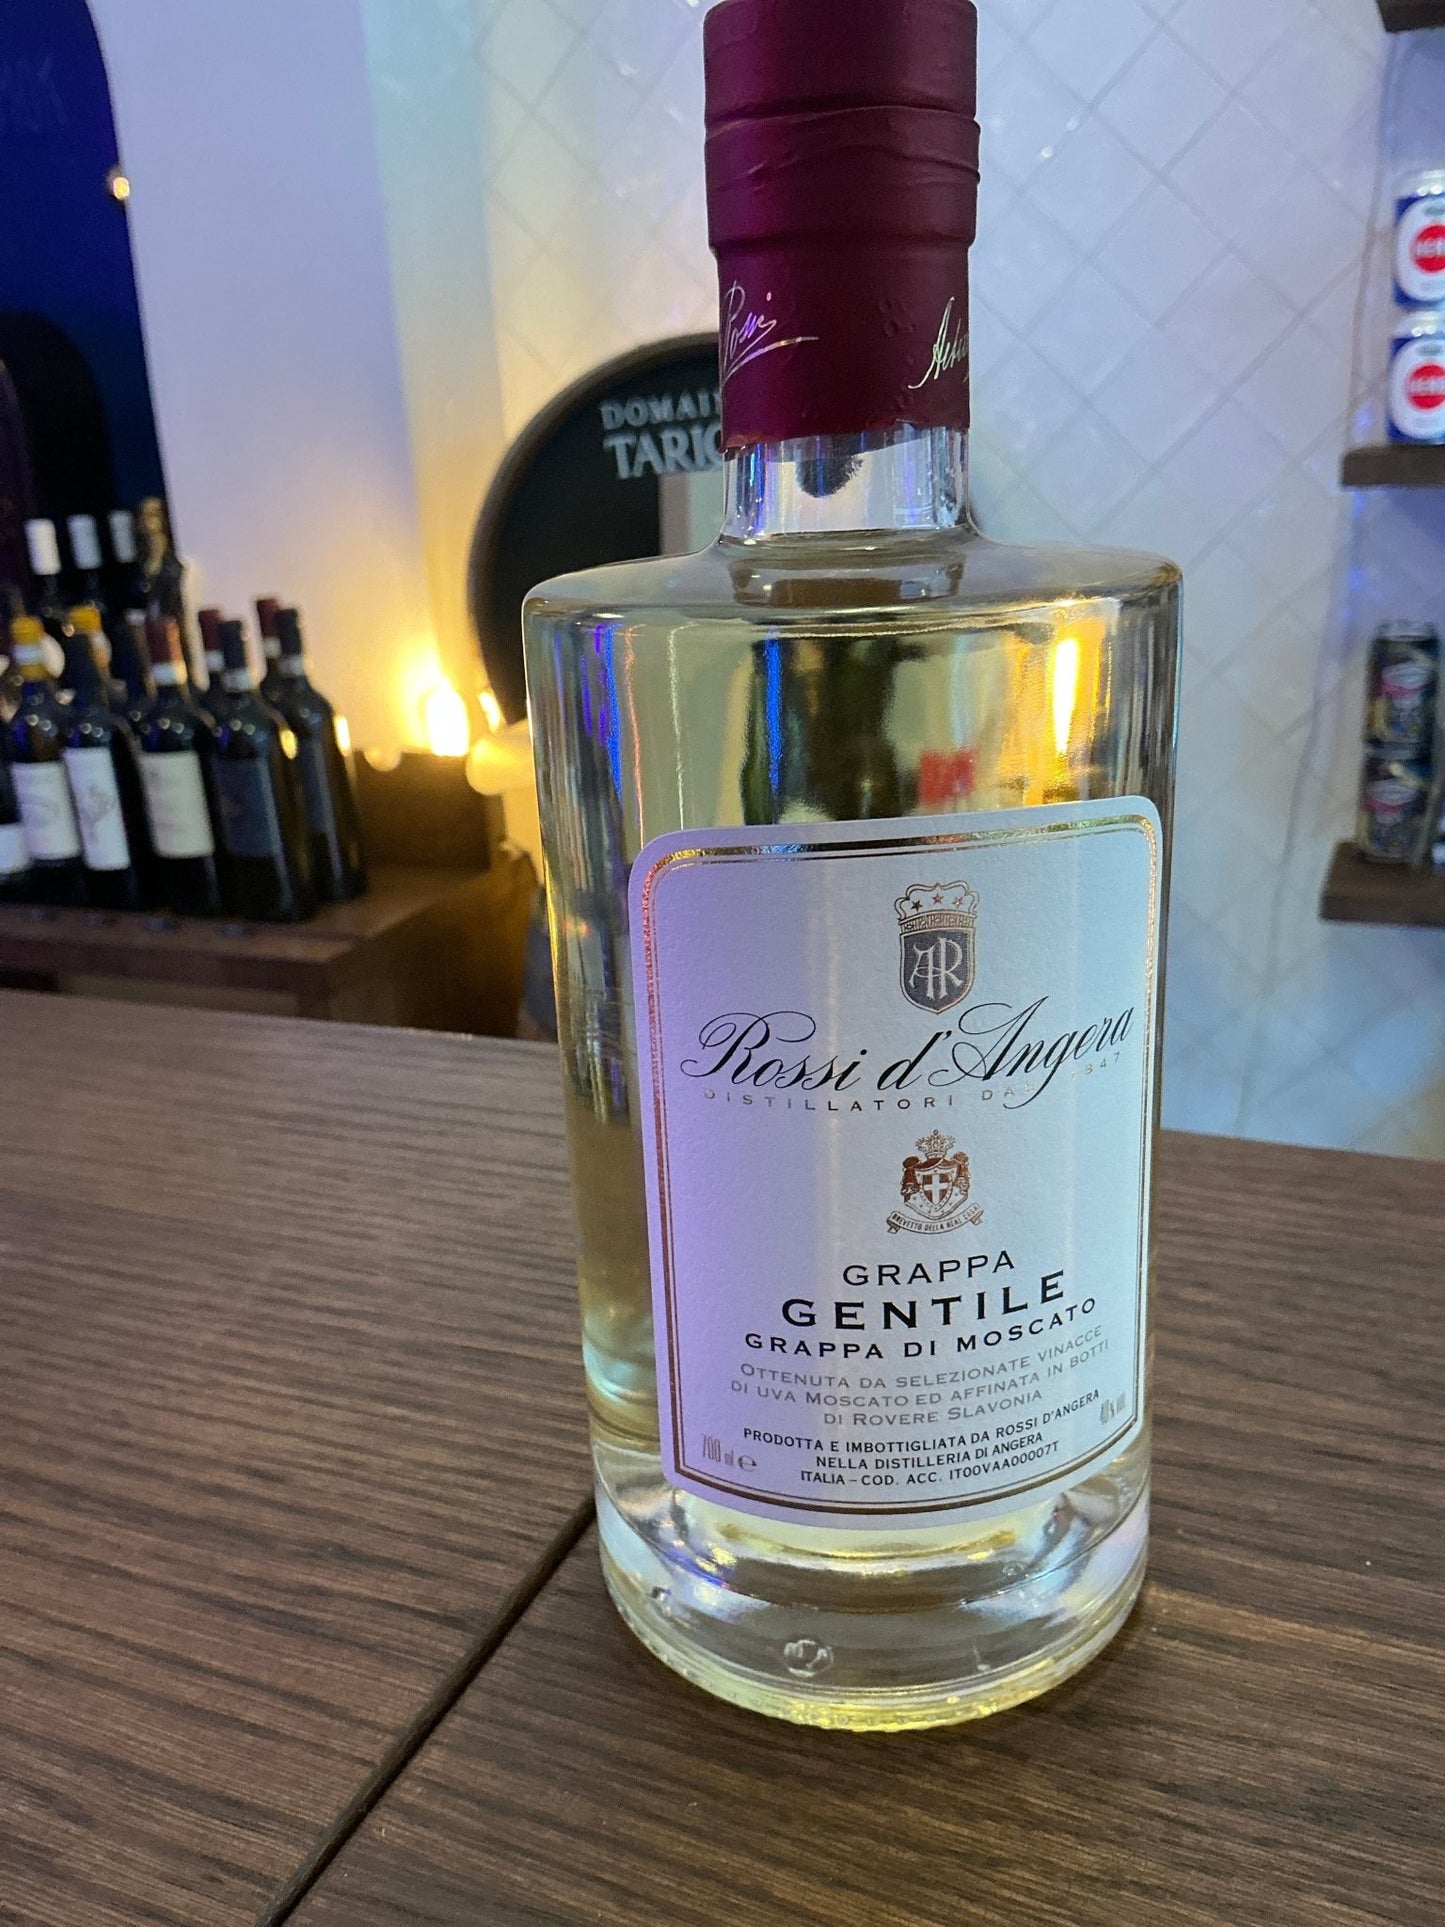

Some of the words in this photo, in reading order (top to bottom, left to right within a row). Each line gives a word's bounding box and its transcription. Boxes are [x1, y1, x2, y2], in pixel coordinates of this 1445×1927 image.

[600, 391, 722, 430] DOMAI
[681, 1010, 868, 1091] Rossi
[703, 1088, 954, 1112] DISTILLATORI
[924, 1223, 945, 1232] DELLA
[842, 1250, 1015, 1287] GRAPPA
[781, 1269, 1065, 1331] GENTILE
[745, 1333, 885, 1360] GRAPPA
[903, 1340, 936, 1358] DI
[957, 1298, 1096, 1353] MOSCATO
[731, 1380, 748, 1394] DI
[757, 1386, 797, 1403] UVA
[806, 1392, 909, 1408] MOSCATO
[915, 1393, 942, 1406] ED
[950, 1372, 1040, 1402] AFFINATA
[1047, 1363, 1064, 1378] IN
[1069, 1339, 1110, 1369] BOTTI
[740, 1363, 850, 1389] OTTENUTA
[860, 1377, 887, 1389] DA
[895, 1355, 1032, 1389] SELEZIONATE
[1038, 1325, 1103, 1363] VINACCE
[743, 1427, 824, 1452] PRODOTTA
[830, 1441, 840, 1453] E
[845, 1434, 967, 1454] IMBOTTIGLIATA
[970, 1431, 990, 1445] DA
[995, 1417, 1038, 1439] ROSSI
[1042, 1388, 1100, 1425] D'ANGERA
[823, 1413, 843, 1425] DI
[853, 1411, 939, 1427] ROVERE
[947, 1389, 1043, 1421] SLAVONIA
[815, 1456, 869, 1470] NELLA
[874, 1450, 971, 1470] DISTILLERIA
[974, 1448, 989, 1460] DI
[991, 1432, 1043, 1457] ANGERA
[800, 1470, 846, 1485] ITALIA
[860, 1475, 900, 1486] COD.
[905, 1472, 942, 1485] ACC.
